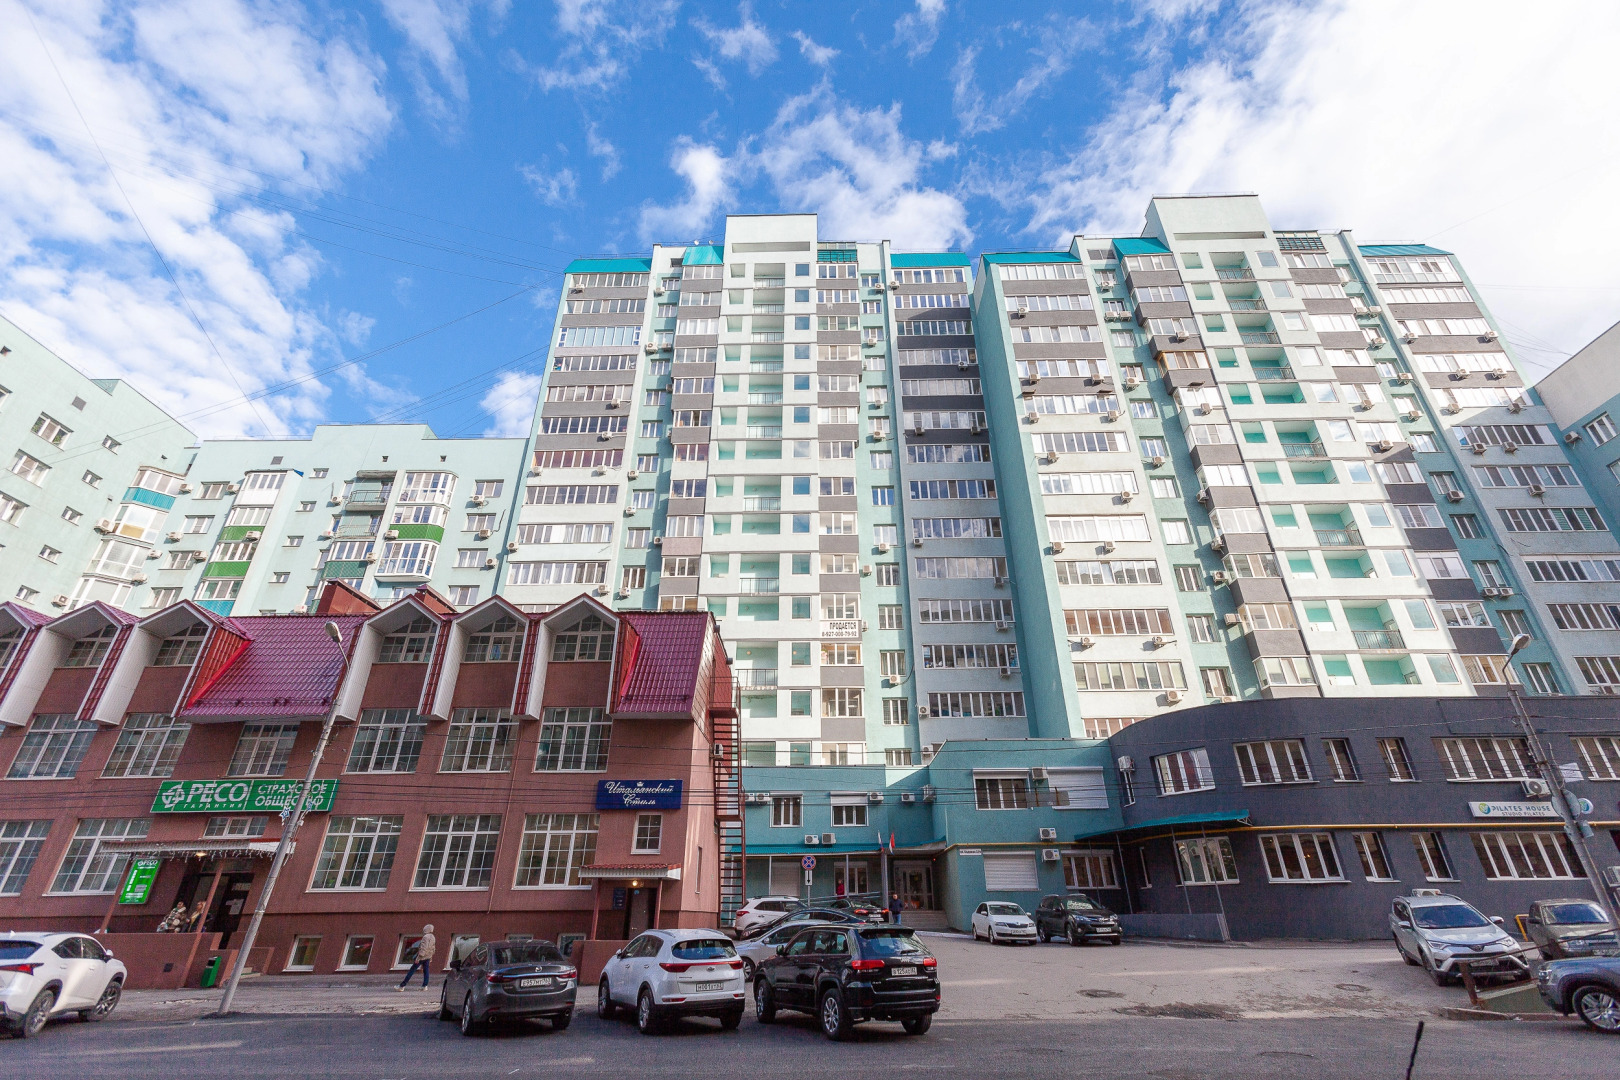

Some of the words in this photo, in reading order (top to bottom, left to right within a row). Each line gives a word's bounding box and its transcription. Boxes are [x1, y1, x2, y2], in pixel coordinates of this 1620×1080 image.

[830, 622, 856, 630] ПРОДАЕТСЯ
[186, 783, 248, 803] РЕСО
[258, 784, 328, 794] СТРАХООЕ
[604, 782, 674, 794] Итальянский
[254, 795, 324, 807] ОБЩЕСВО
[623, 794, 656, 807] Стиль
